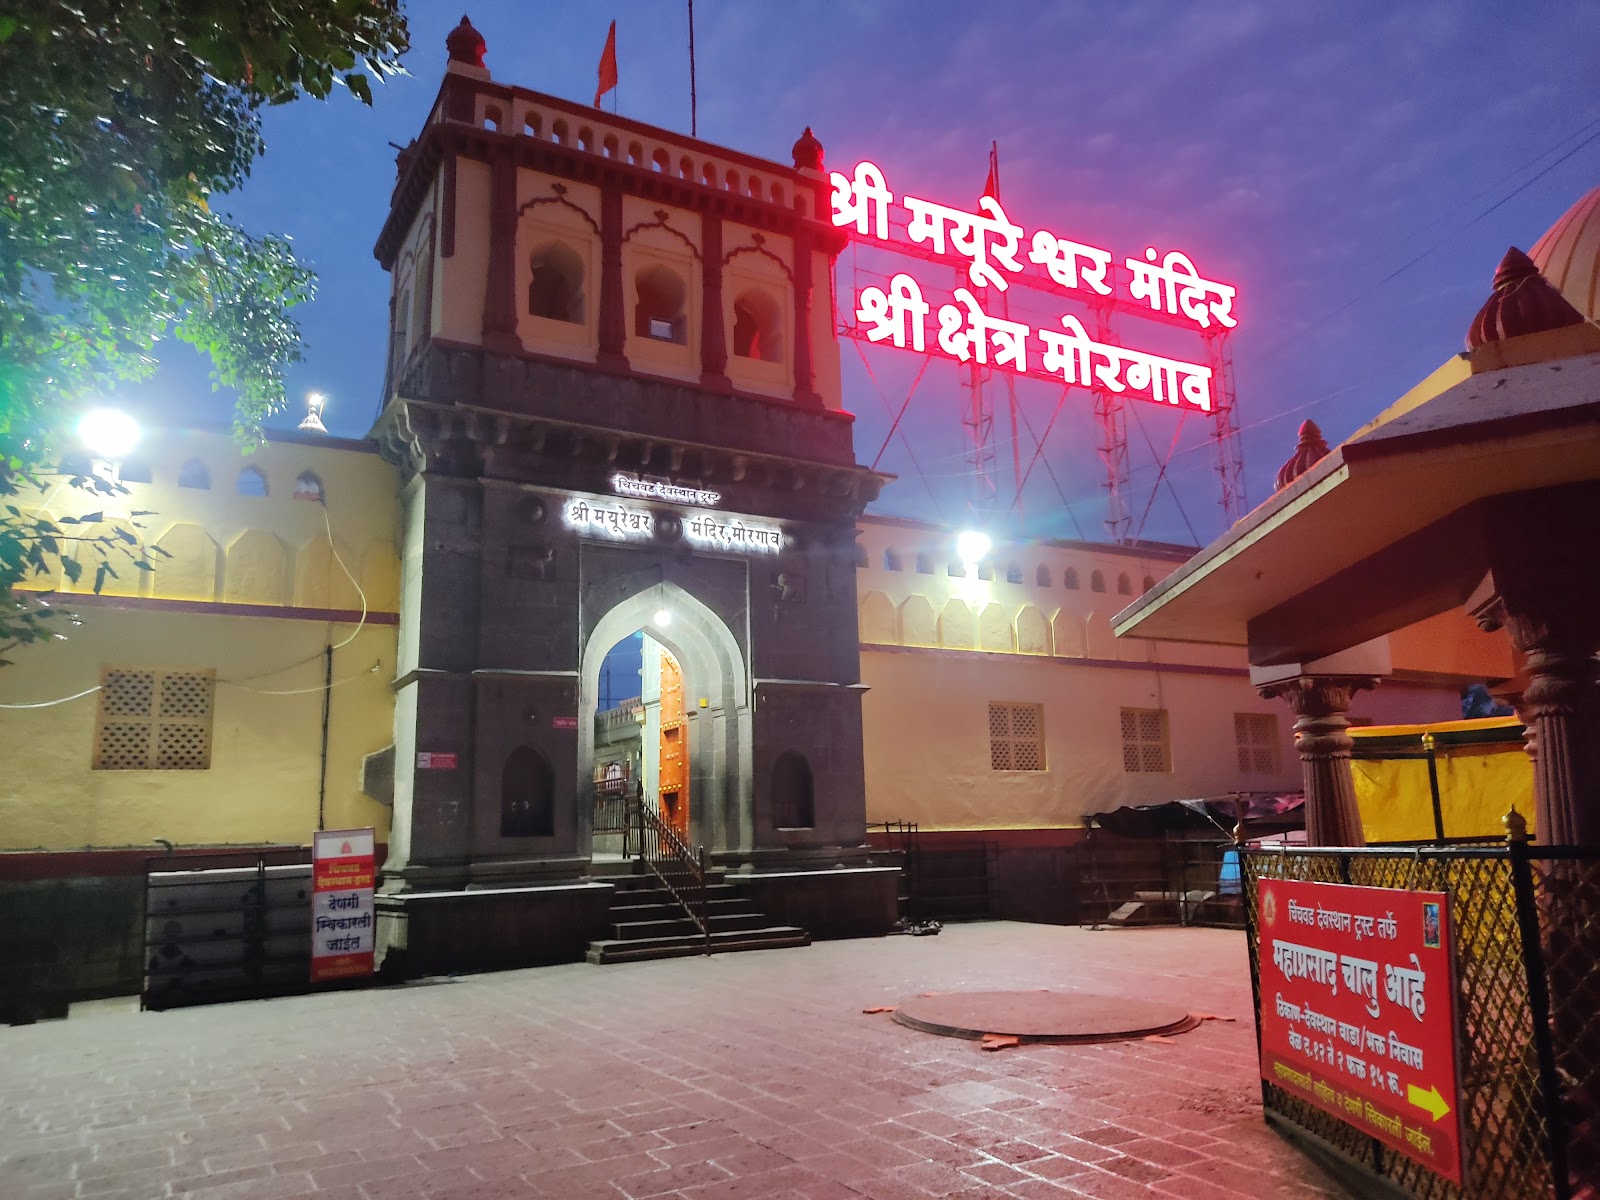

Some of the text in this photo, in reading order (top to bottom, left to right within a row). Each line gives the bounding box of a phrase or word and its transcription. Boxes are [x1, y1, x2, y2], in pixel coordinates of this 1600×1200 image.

[830, 161, 893, 240] श्री
[1125, 247, 1238, 329] मंदिर
[856, 273, 1212, 412] श्री क्षेत्र मोरगाव
[571, 505, 589, 523] श्री
[328, 893, 359, 911] देणगी
[1288, 899, 1398, 941] चिंचवड देवस्थान ट्रस्ट तर्फे
[327, 933, 360, 951] जाईल
[1273, 939, 1337, 996] महाप्रसाद
[1384, 953, 1425, 1022] आहे
[1388, 1030, 1424, 1070] निवास
